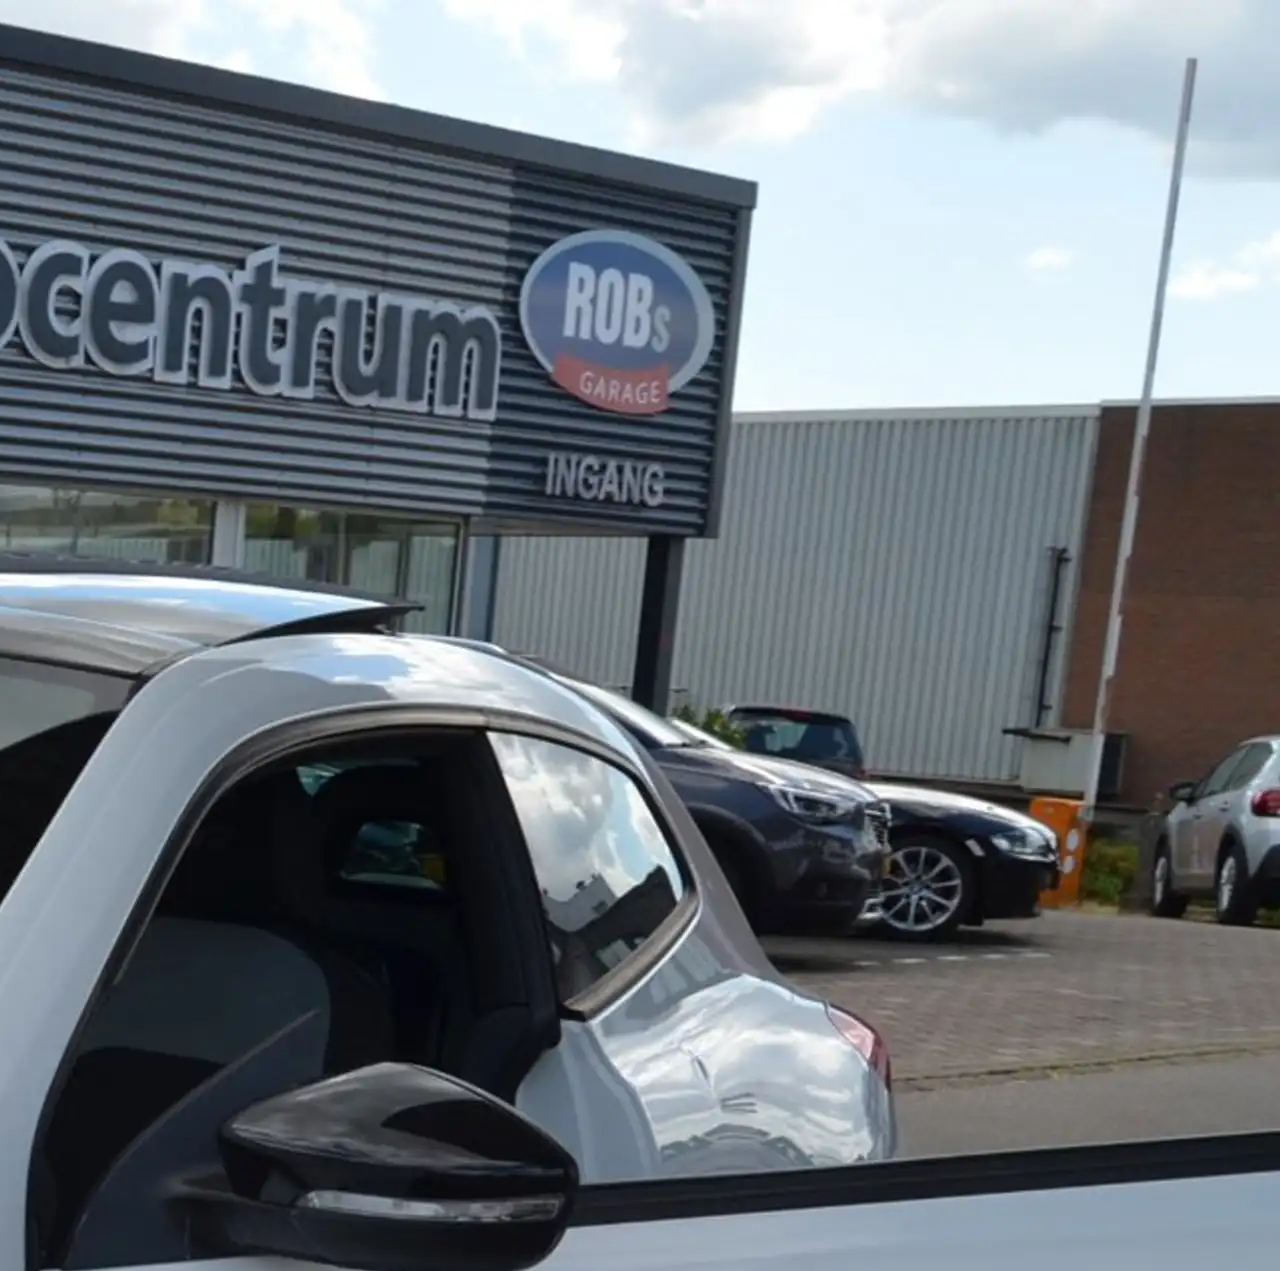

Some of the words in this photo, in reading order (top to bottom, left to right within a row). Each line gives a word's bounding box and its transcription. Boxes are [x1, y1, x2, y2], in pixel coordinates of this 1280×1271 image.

[562, 261, 671, 354] ROBs
[579, 371, 662, 405] GARAGE
[545, 452, 665, 507] INGANG
